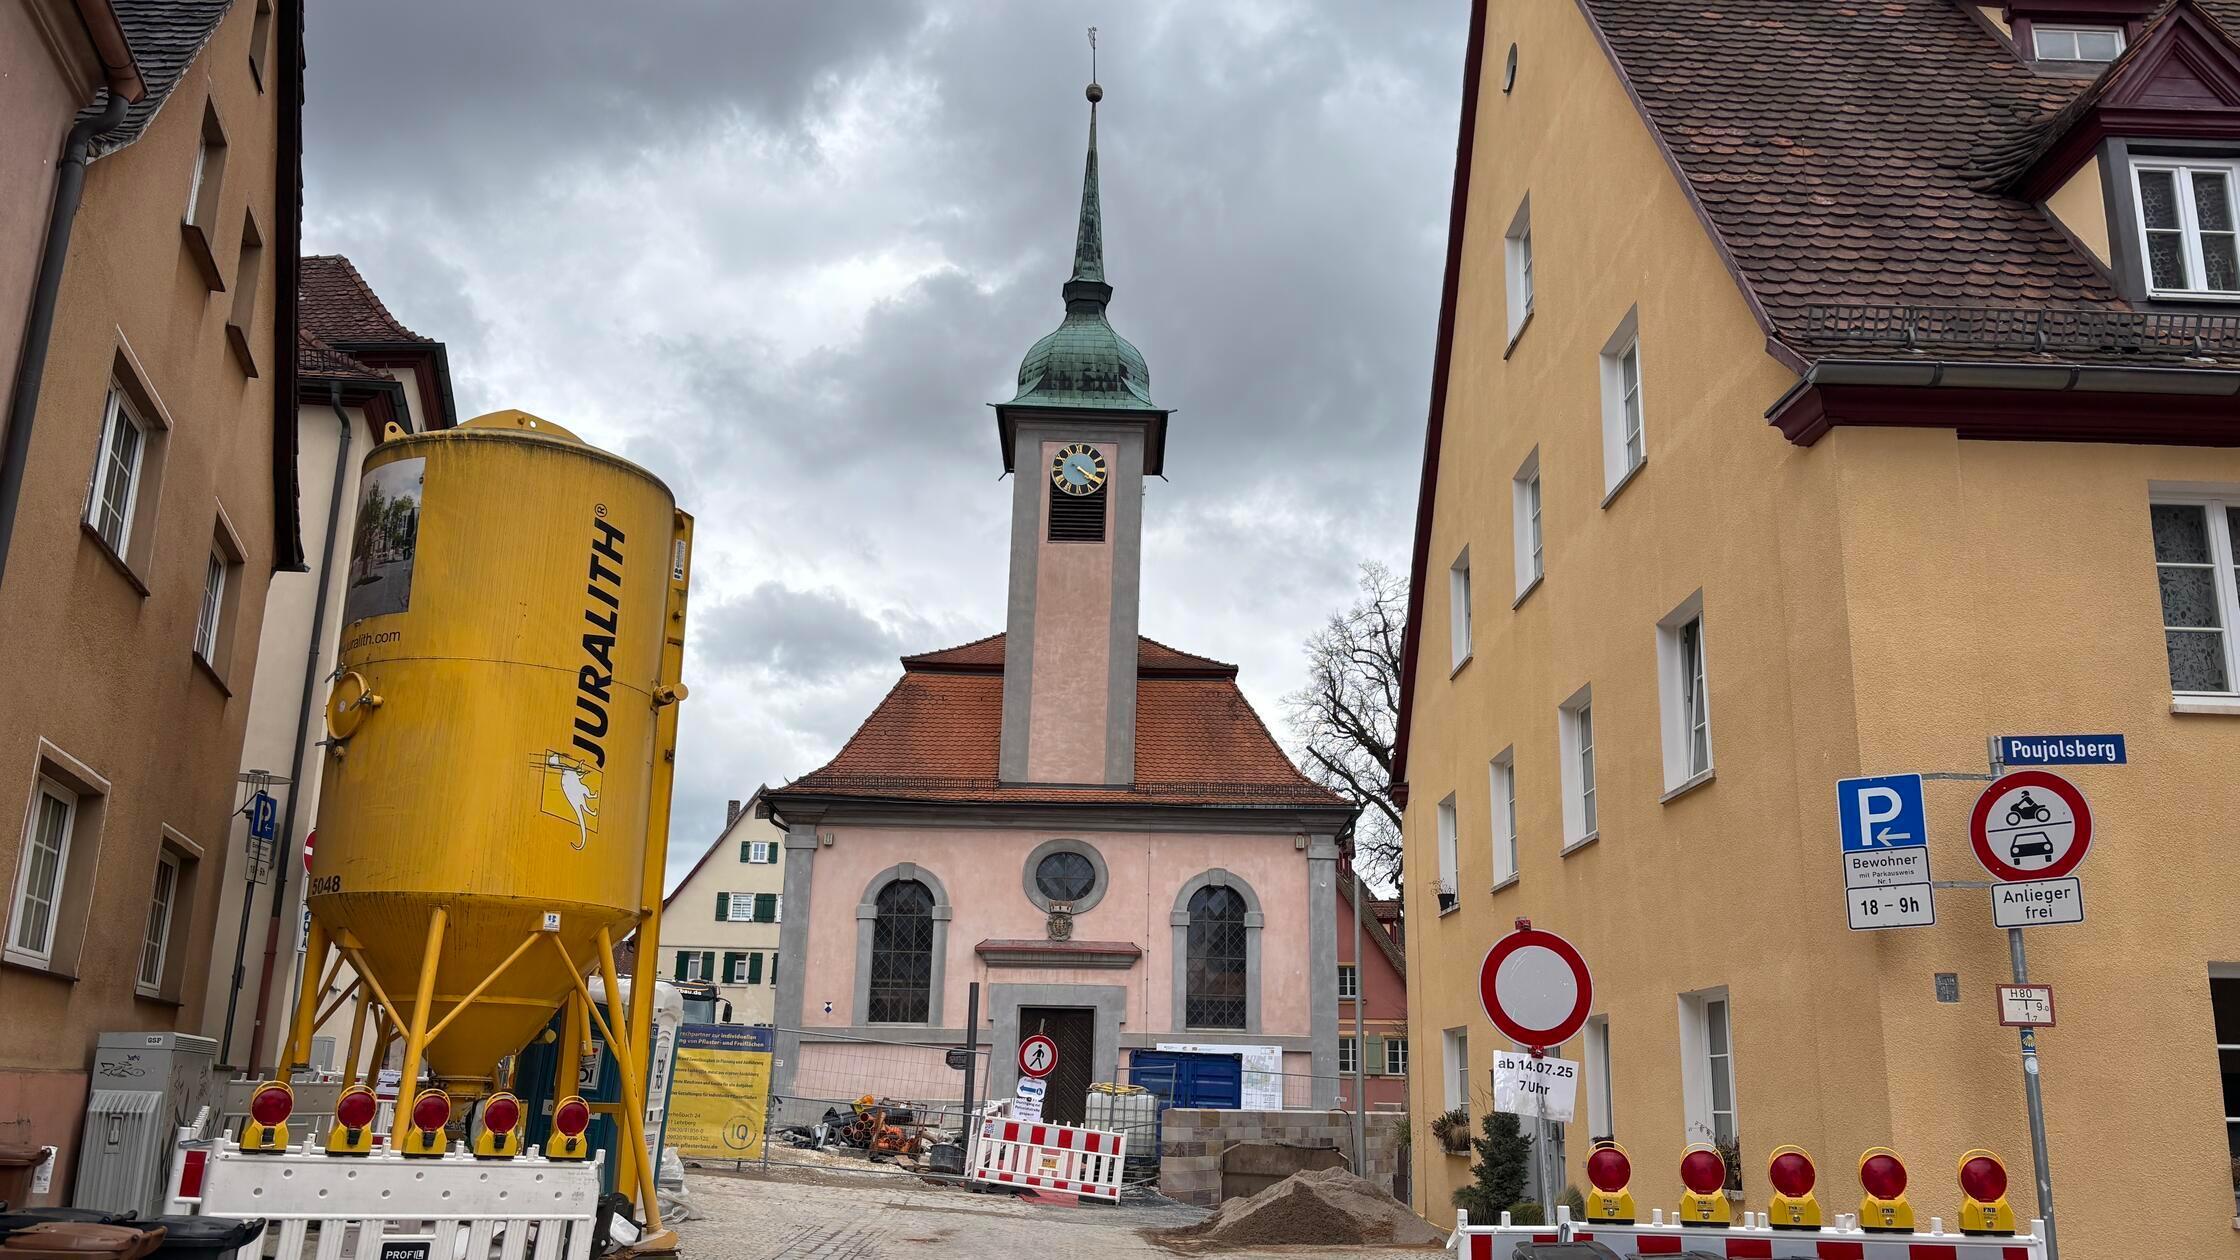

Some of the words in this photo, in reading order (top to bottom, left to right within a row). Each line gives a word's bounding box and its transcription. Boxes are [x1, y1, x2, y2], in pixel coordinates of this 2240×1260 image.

[2011, 740, 2116, 761] Poujolsberg
[1857, 786, 1902, 846] P
[1852, 855, 1918, 869] Bewohner
[1872, 869, 1915, 878] Parkausweis
[312, 875, 341, 895] 5048
[2003, 887, 2071, 904] Anlieger
[1860, 898, 1879, 916] 18
[1900, 897, 1920, 914] 9h
[2025, 906, 2053, 919] frei
[1498, 1059, 1515, 1069] ab
[1518, 1060, 1573, 1078] 14.07.25
[1519, 1080, 1526, 1091] 7
[1528, 1082, 1550, 1095] Uhr
